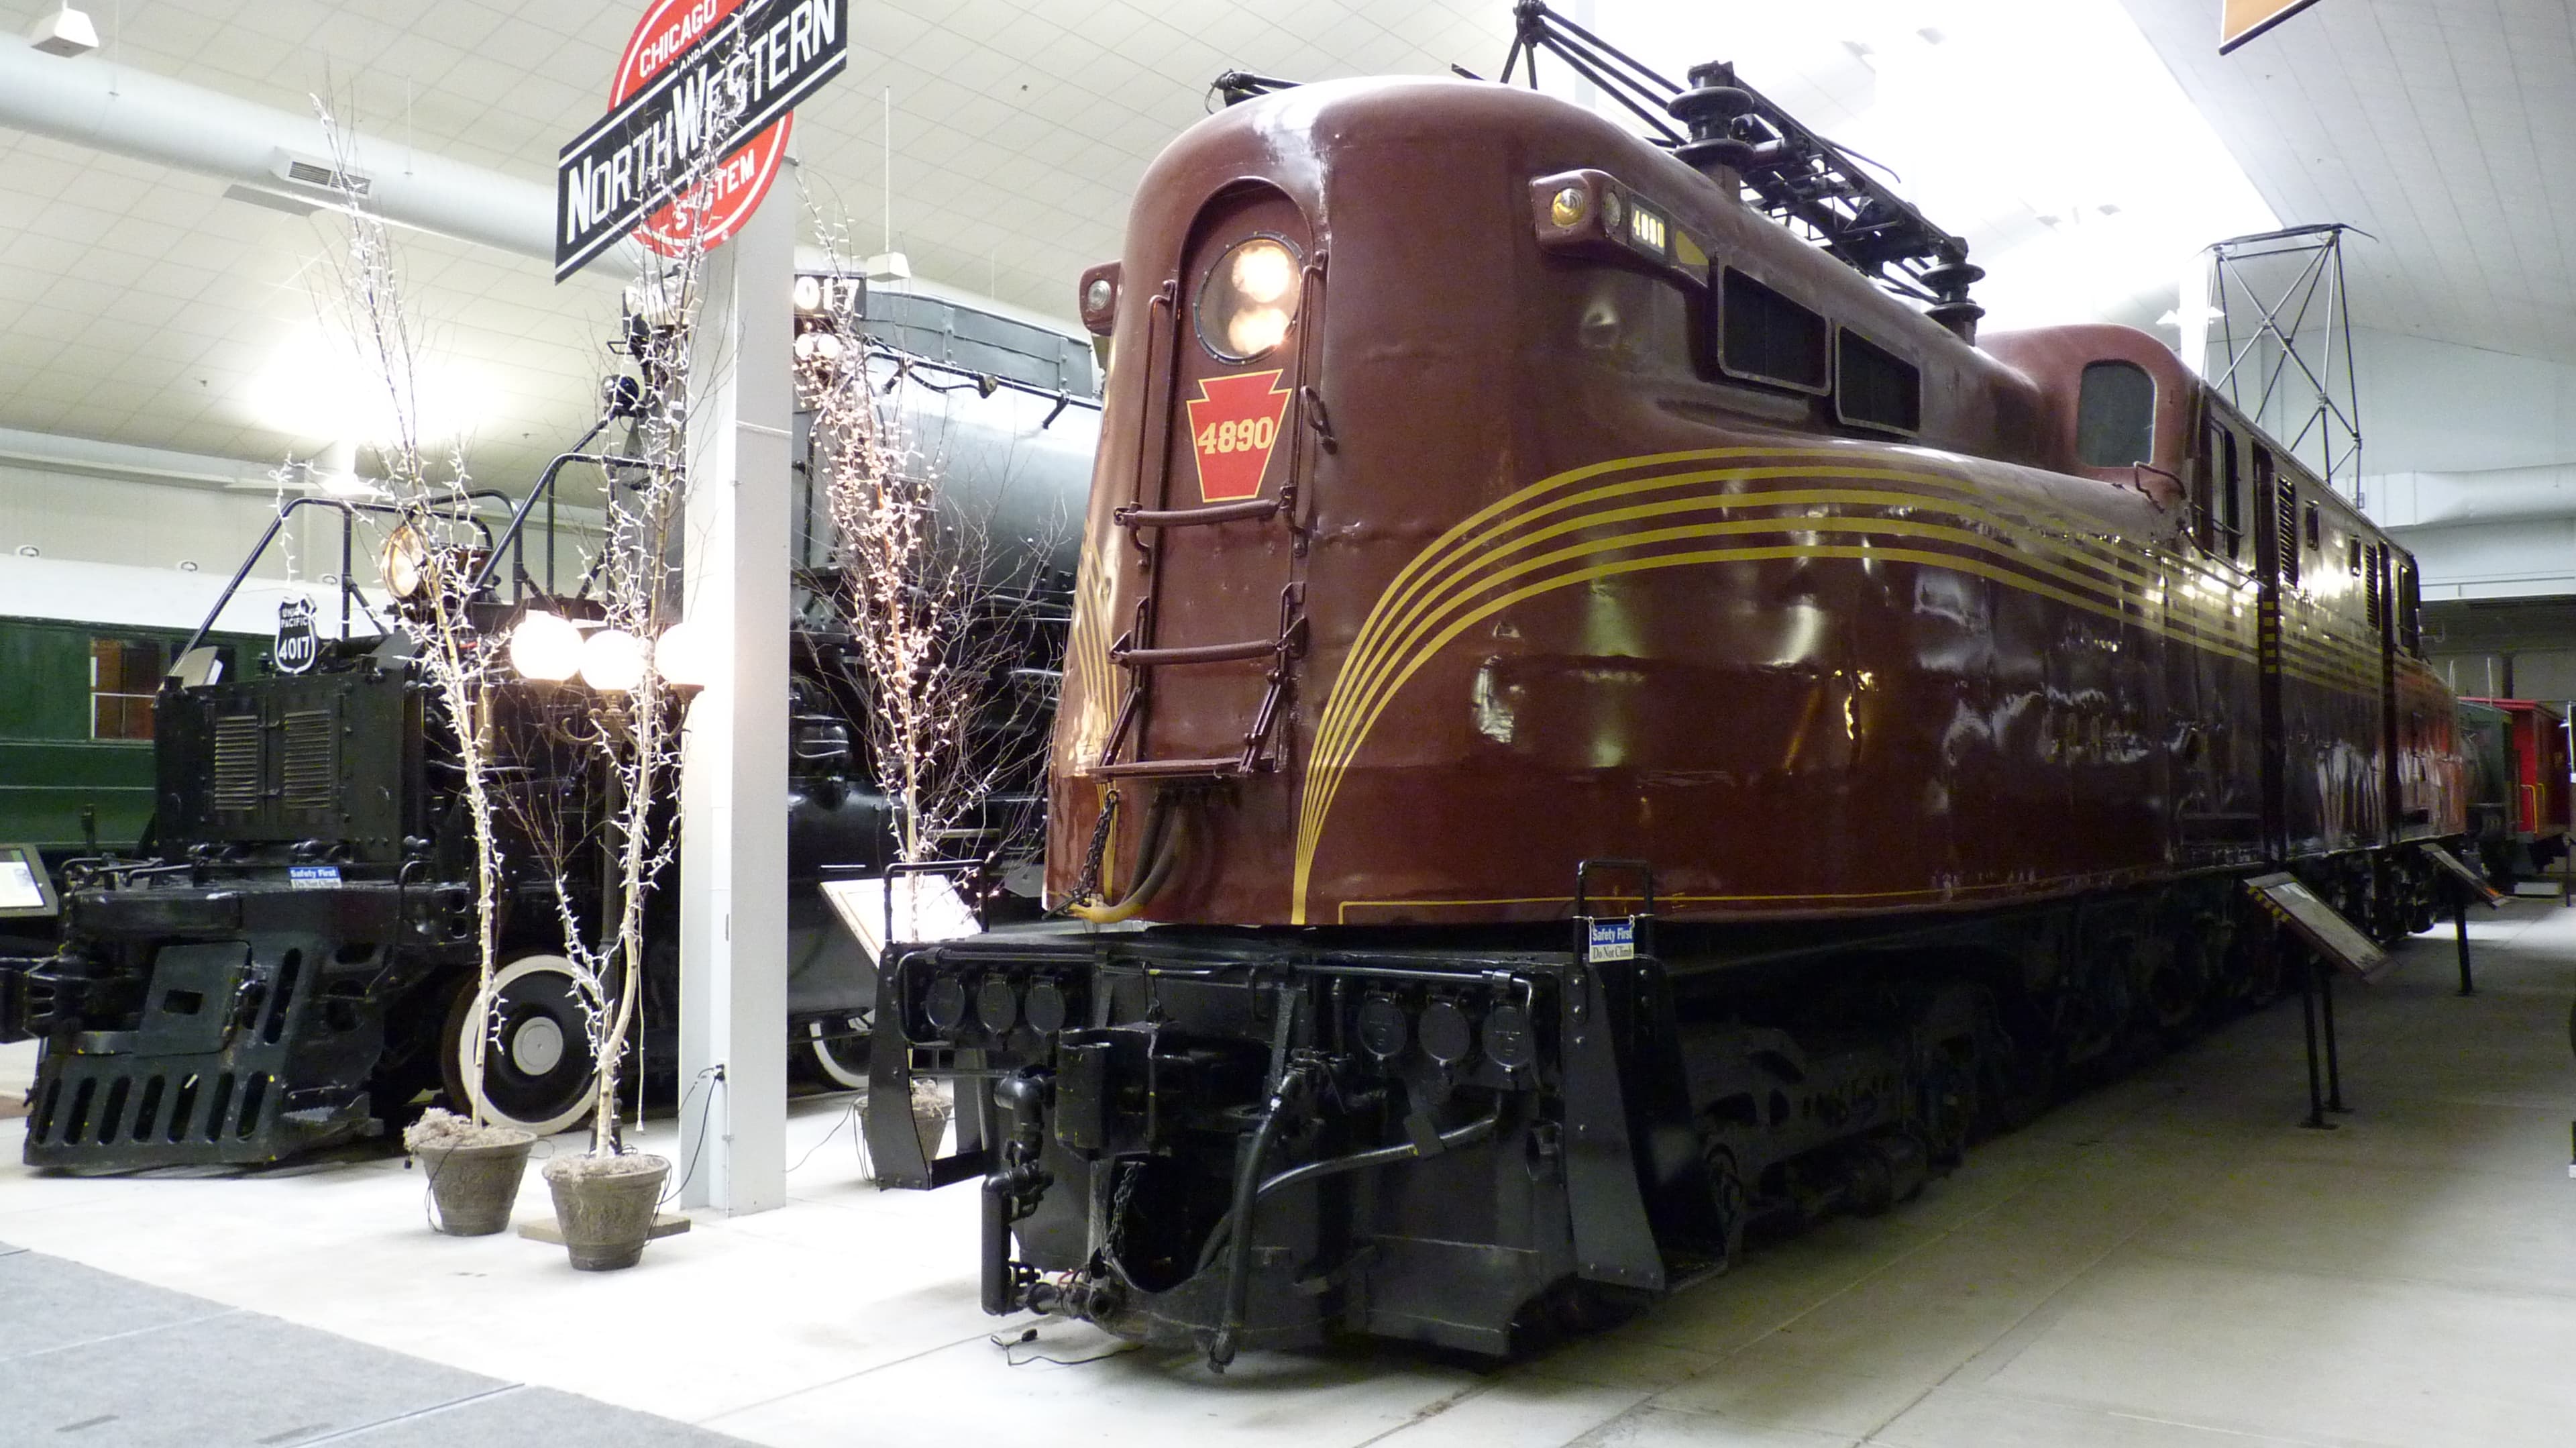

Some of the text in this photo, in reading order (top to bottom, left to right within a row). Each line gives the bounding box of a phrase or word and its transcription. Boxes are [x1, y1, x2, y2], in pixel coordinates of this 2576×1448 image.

[640, 0, 716, 78] CHICAGO
[680, 48, 701, 73] AND
[1197, 416, 1274, 454] 4890
[282, 606, 307, 618] UNIN
[281, 617, 309, 628] PACIFIC
[278, 635, 310, 660] 4017
[290, 869, 337, 878] Safety First
[1592, 927, 1633, 943] Safety First
[1593, 945, 1633, 960] Do Not Climb
